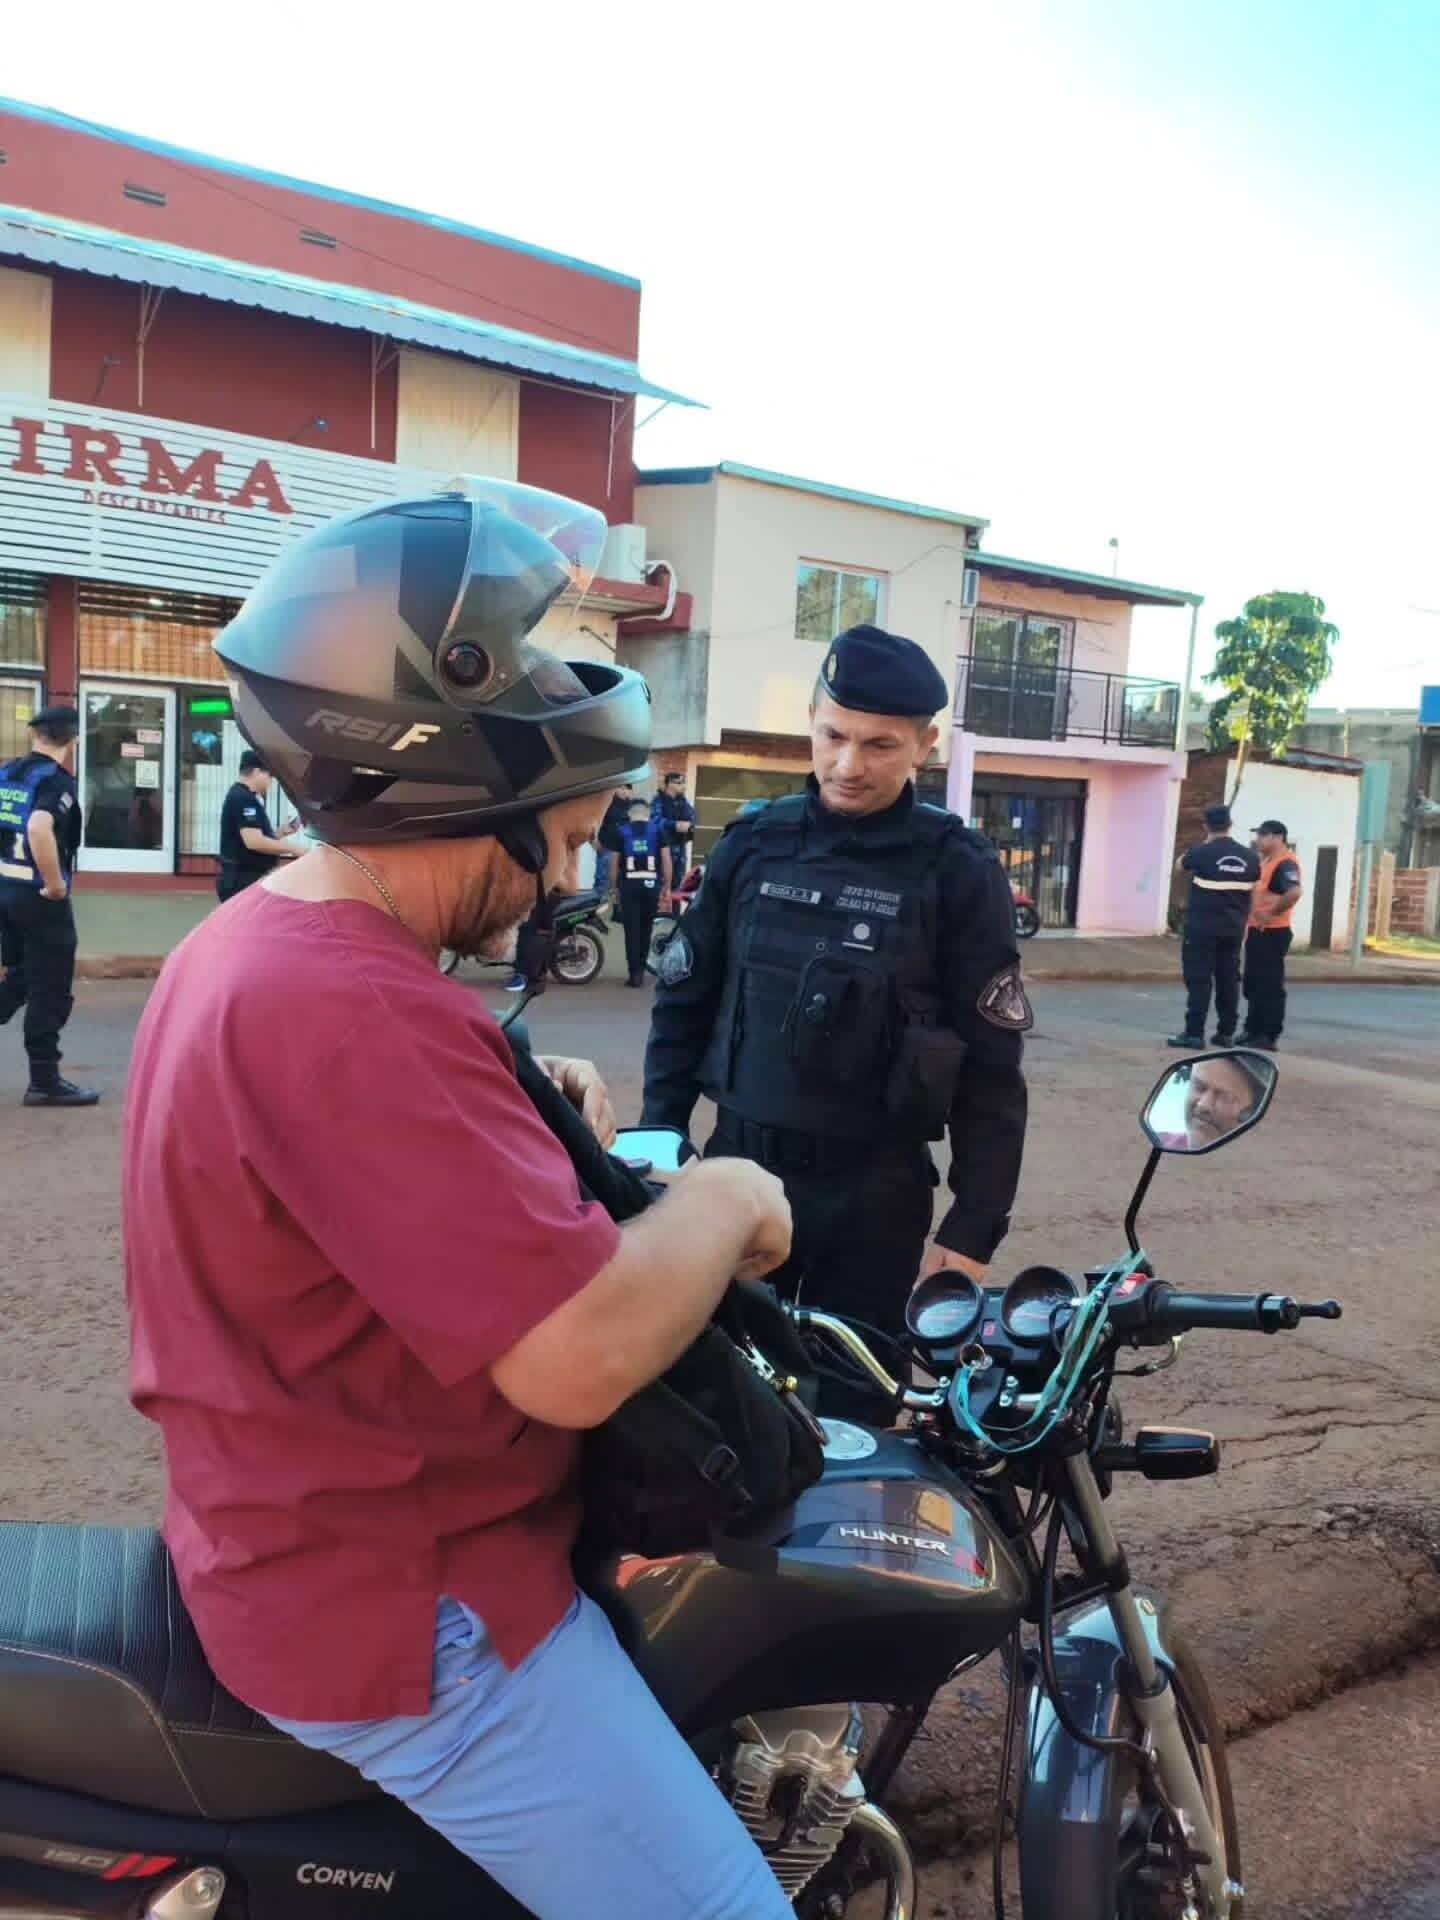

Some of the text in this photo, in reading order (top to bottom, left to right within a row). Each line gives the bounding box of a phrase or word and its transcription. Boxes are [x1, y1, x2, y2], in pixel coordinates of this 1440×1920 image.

[11, 416, 293, 514] IRMA
[839, 1526, 951, 1556] HUNTER
[296, 1863, 395, 1893] CORVEN
